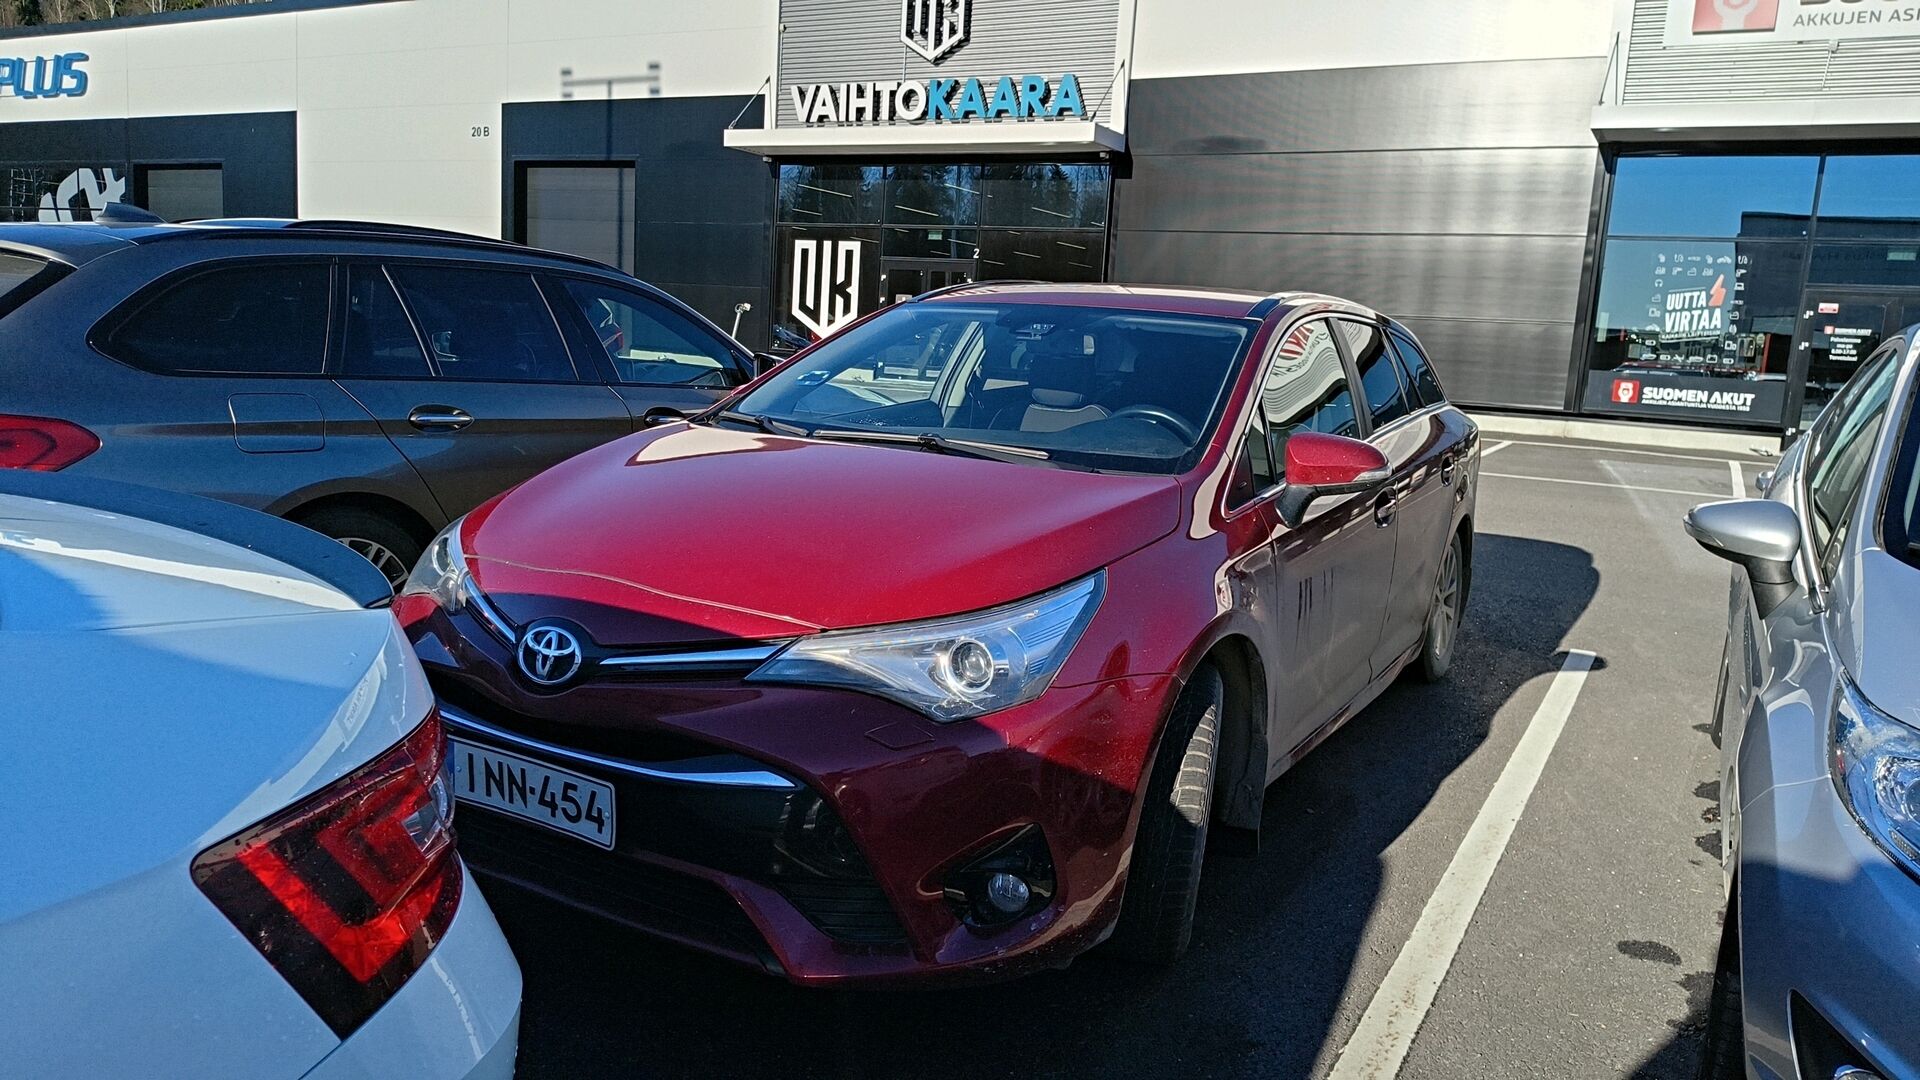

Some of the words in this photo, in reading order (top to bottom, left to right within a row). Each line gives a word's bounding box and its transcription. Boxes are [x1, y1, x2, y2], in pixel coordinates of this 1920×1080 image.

[1793, 10, 1882, 27] AKKUJEN
[791, 74, 1086, 123] VAIHTOKAARA
[471, 126, 481, 137] 20
[484, 126, 490, 137] B
[972, 248, 980, 259] 2
[1666, 291, 1706, 310] UUTTA
[1665, 308, 1721, 333] VIRTAA
[1642, 386, 1708, 403] SUOMEN
[1709, 391, 1756, 406] AKUT
[467, 753, 605, 835] INN-454
